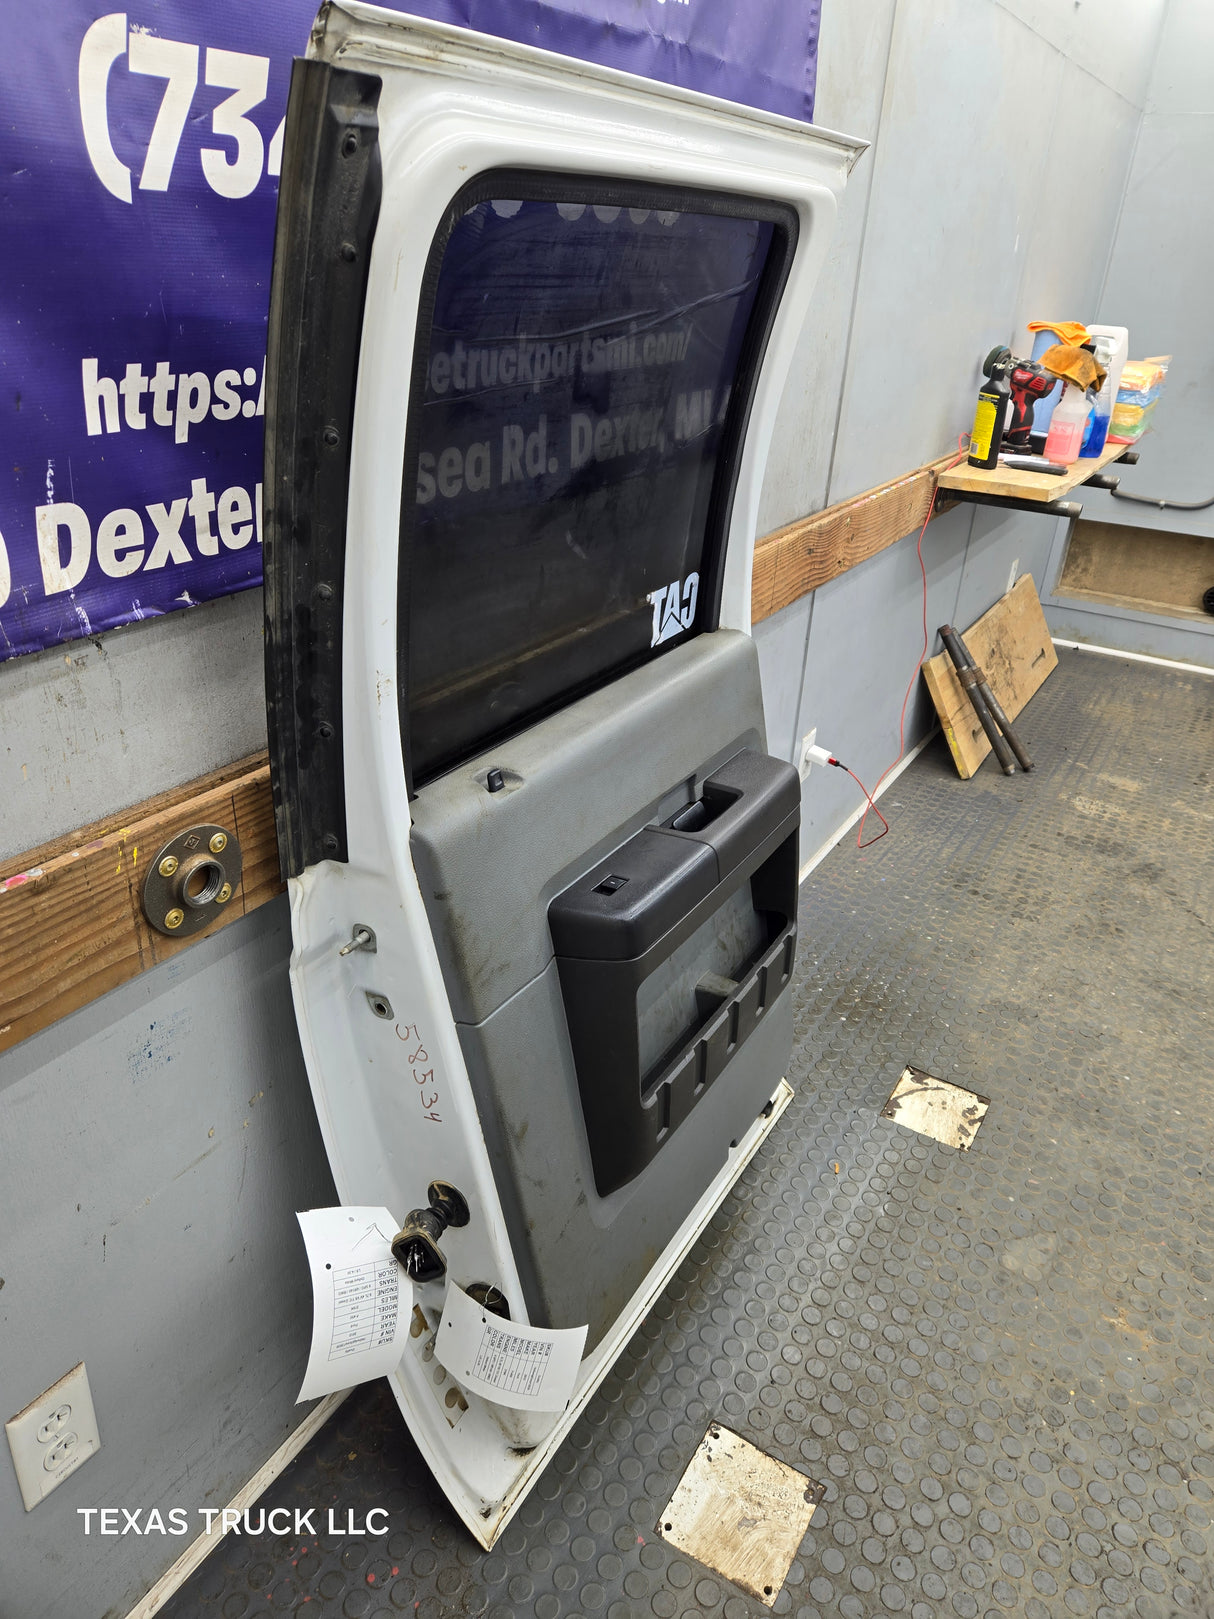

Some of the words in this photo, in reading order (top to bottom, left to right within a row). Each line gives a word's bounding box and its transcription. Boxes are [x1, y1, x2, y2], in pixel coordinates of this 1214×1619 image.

[425, 322, 693, 393] etruckpartsmi.com/
[501, 414, 558, 485] Rd.
[395, 1022, 443, 1123] 58534
[377, 1268, 398, 1278] COLOR
[379, 1277, 398, 1287] TRANS
[377, 1286, 398, 1297] ENGINE
[380, 1295, 398, 1304] MILES
[378, 1304, 398, 1313] MODEL
[381, 1312, 397, 1321] MAKE
[380, 1321, 396, 1330] YEAR
